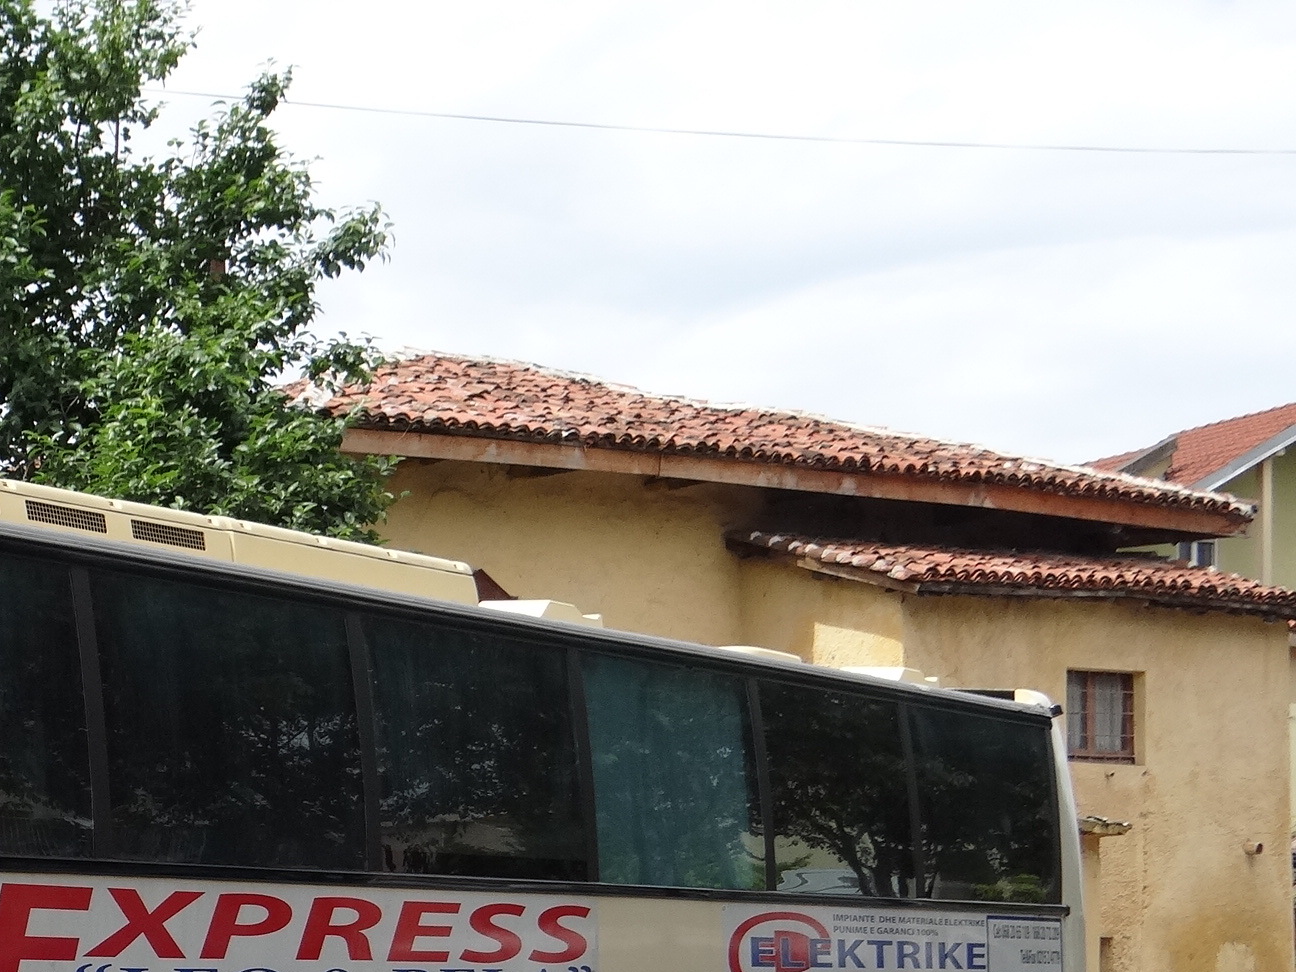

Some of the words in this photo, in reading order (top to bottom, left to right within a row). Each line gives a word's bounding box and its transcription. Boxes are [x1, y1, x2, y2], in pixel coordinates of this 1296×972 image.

[832, 913, 875, 923] IMPIANTE
[879, 915, 896, 924] DHE
[898, 917, 944, 926] MATERIALE
[944, 919, 985, 927] ELEKTRIKE
[833, 926, 868, 934] PUNIME
[869, 927, 875, 935] E
[917, 928, 939, 936] 100%
[750, 936, 986, 970] ELEKTRIKE
